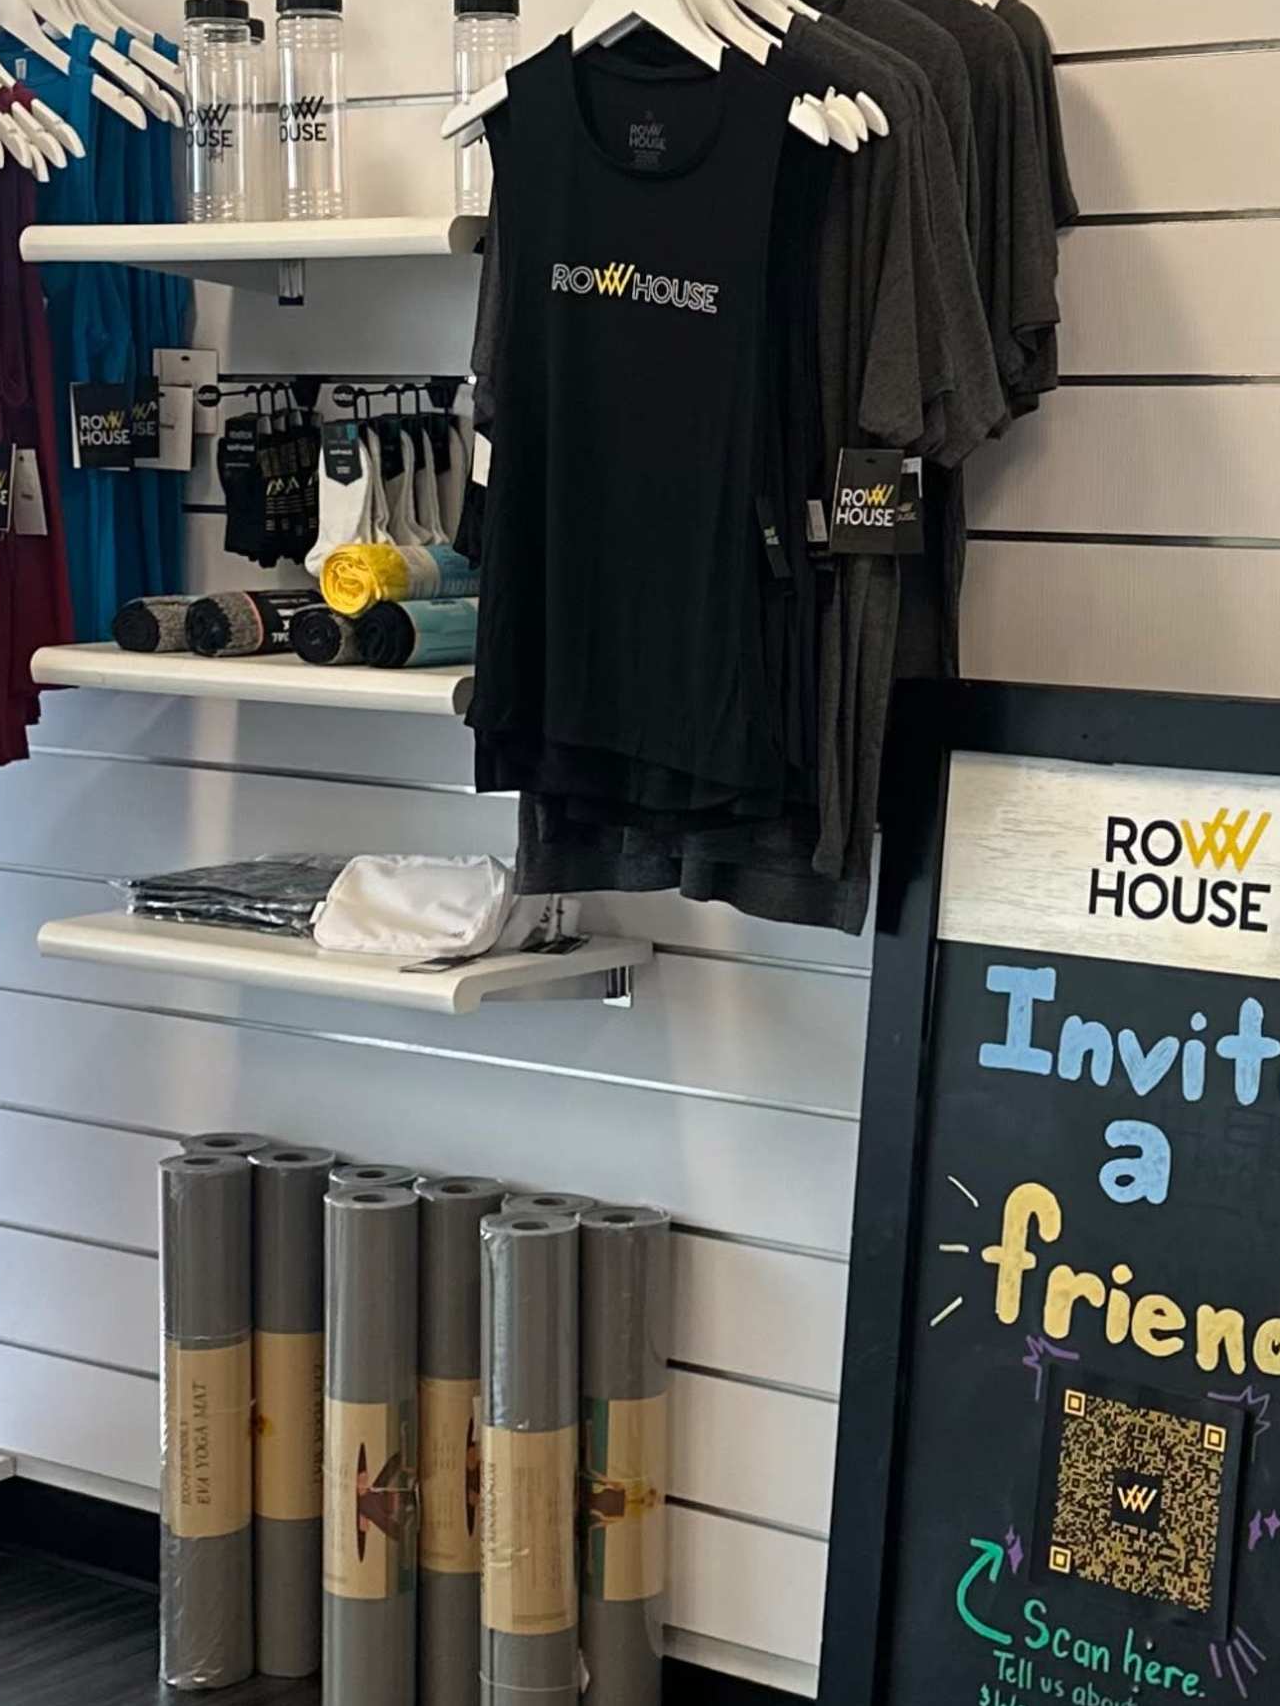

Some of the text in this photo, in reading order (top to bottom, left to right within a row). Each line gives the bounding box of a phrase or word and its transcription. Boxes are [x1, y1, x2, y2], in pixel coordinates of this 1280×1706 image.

[186, 103, 231, 127] OW
[279, 96, 324, 122] OW
[185, 130, 232, 149] OUSE
[279, 123, 327, 143] OUSE
[552, 262, 718, 314] ROW HOUSE
[80, 430, 131, 446] HOUSE
[841, 484, 894, 506] ROW
[836, 508, 895, 527] HOUSE
[1106, 807, 1272, 873] ROW
[1089, 869, 1272, 933] HOUSE
[1098, 1118, 1172, 1205] a
[192, 1380, 211, 1505] EVA YOGA MAT
[1024, 1599, 1206, 1697] Scan here.
[993, 1650, 1033, 1690] Tell
[1040, 1675, 1065, 1697] us
